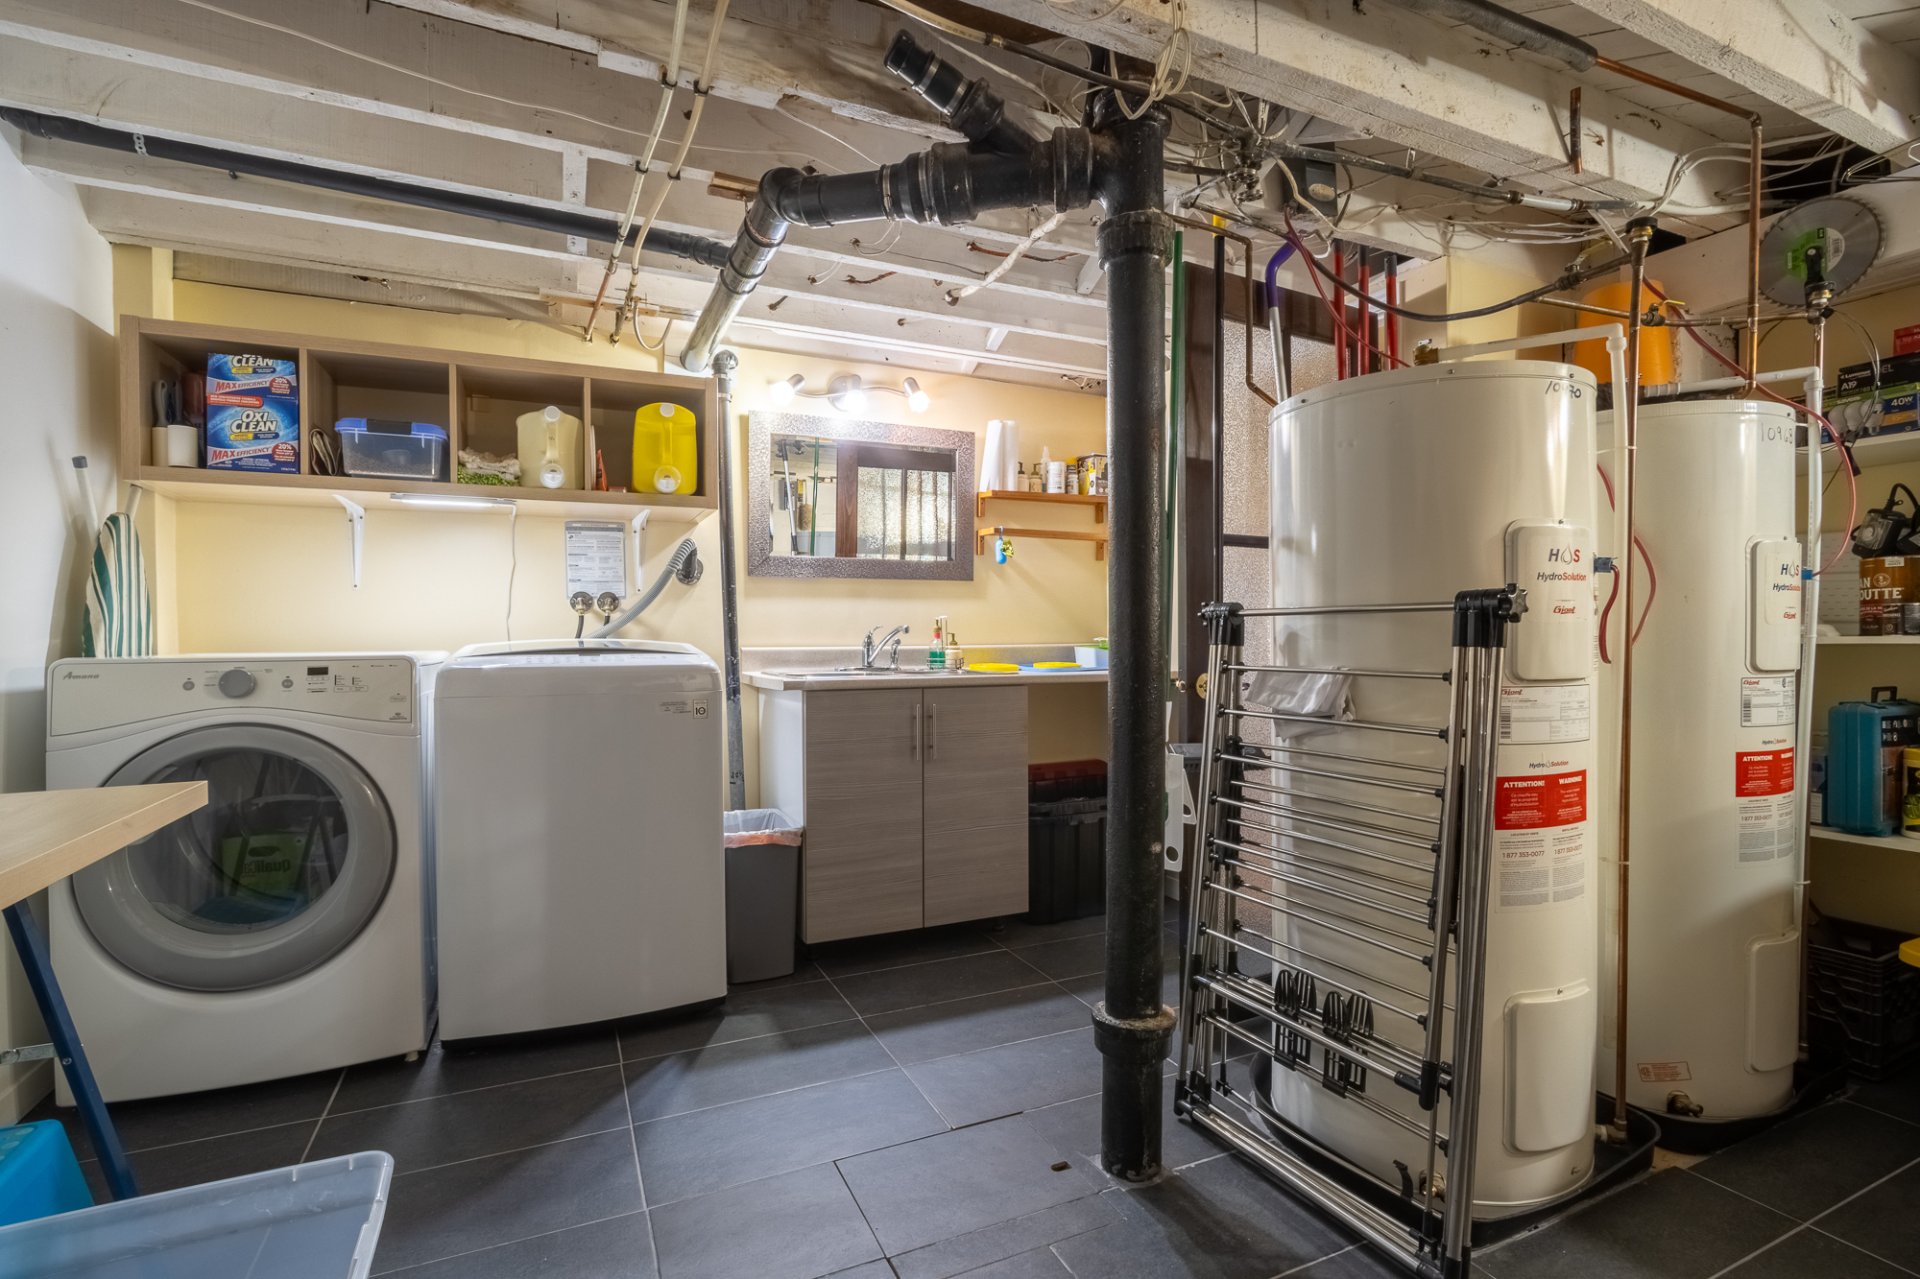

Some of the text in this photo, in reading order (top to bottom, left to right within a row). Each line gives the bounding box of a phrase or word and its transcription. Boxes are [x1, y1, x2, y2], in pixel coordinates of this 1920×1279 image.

[215, 382, 236, 392] MAX
[238, 380, 269, 388] EFFICIENCY
[1840, 380, 1858, 391] A19
[1890, 396, 1914, 406] 40W
[242, 410, 269, 422] OXI
[231, 420, 277, 433] CLEAN
[212, 450, 236, 462] MAX
[236, 446, 270, 456] EFFICIENCY
[1537, 572, 1586, 582] HydroSolution
[63, 672, 100, 680] Amana
